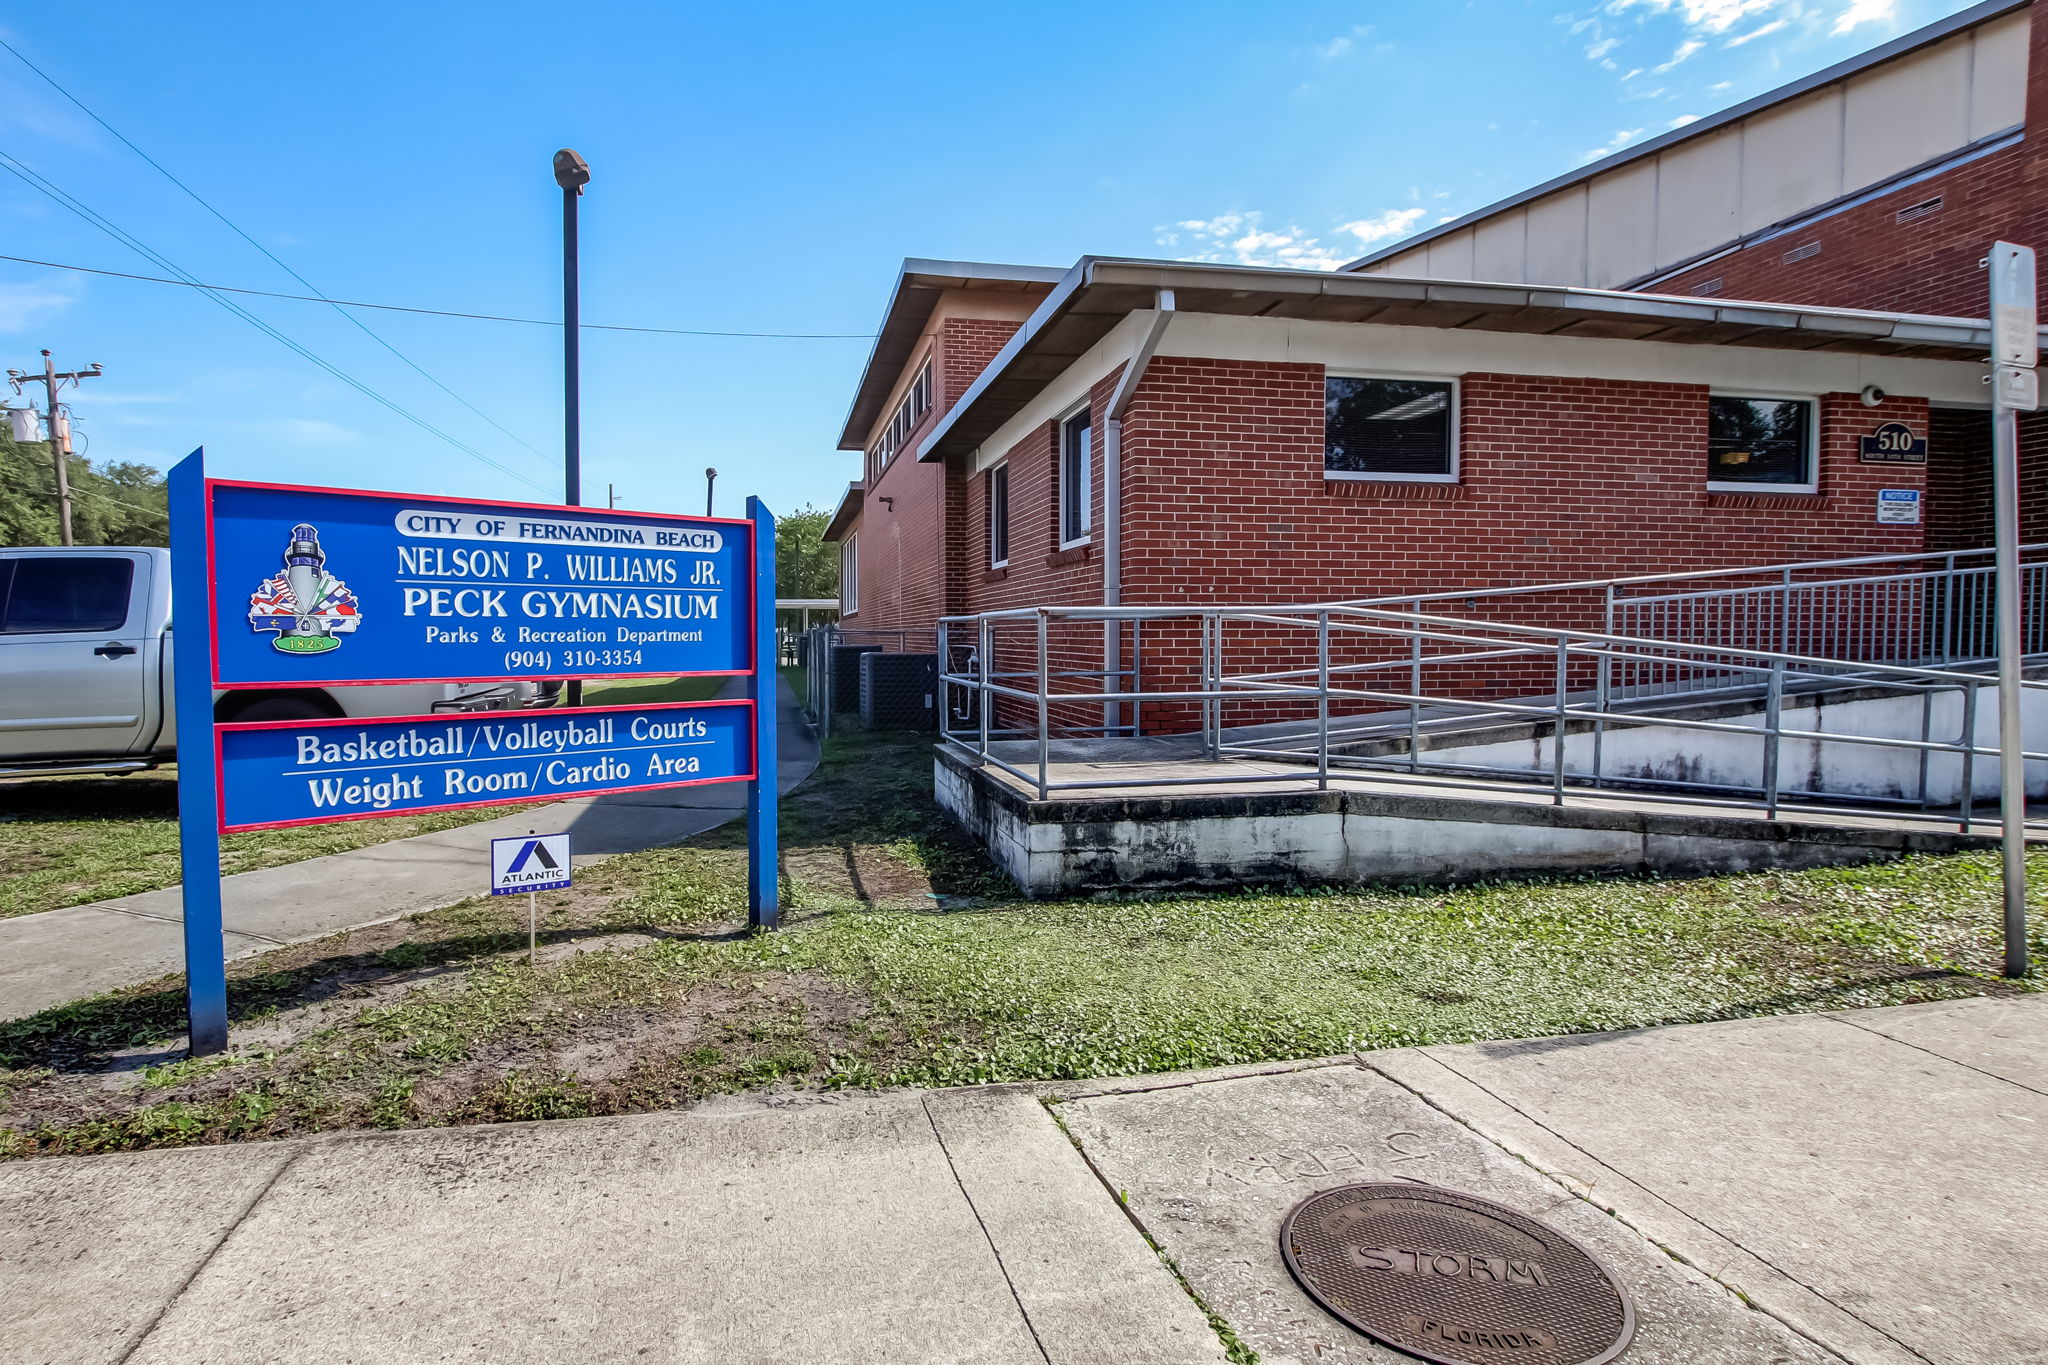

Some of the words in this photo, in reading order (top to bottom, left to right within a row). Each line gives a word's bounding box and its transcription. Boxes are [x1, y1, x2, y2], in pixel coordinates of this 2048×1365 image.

[1879, 431, 1912, 450] 510
[1885, 492, 1913, 500] NOTICE
[407, 515, 462, 534] CITY
[476, 519, 506, 536] OF
[519, 522, 645, 545] FERNANDINA
[655, 531, 715, 549] BEACH
[397, 545, 510, 578] NELSON
[526, 552, 550, 580] P.
[566, 553, 678, 584] WILLIAMS
[690, 560, 721, 585] JR.
[403, 587, 509, 618] PECK
[521, 590, 719, 619] GYMNASIUM
[289, 639, 324, 649] 1825
[425, 626, 479, 643] Parks
[491, 626, 506, 643] &
[518, 626, 607, 643] Recreation
[616, 626, 703, 646] Department
[504, 650, 552, 671] (904)
[563, 649, 643, 667] 310-3354
[296, 718, 615, 765] Basketball/Volleyball
[630, 716, 708, 742] Courts
[308, 772, 424, 808] Weight
[444, 757, 632, 796] Room/Cardio
[646, 752, 701, 778] Area
[500, 881, 565, 895] SECURITY
[502, 869, 564, 884] ATLANTIC
[1359, 1246, 1543, 1287] STORM
[1421, 1318, 1543, 1349] FLORIDA
